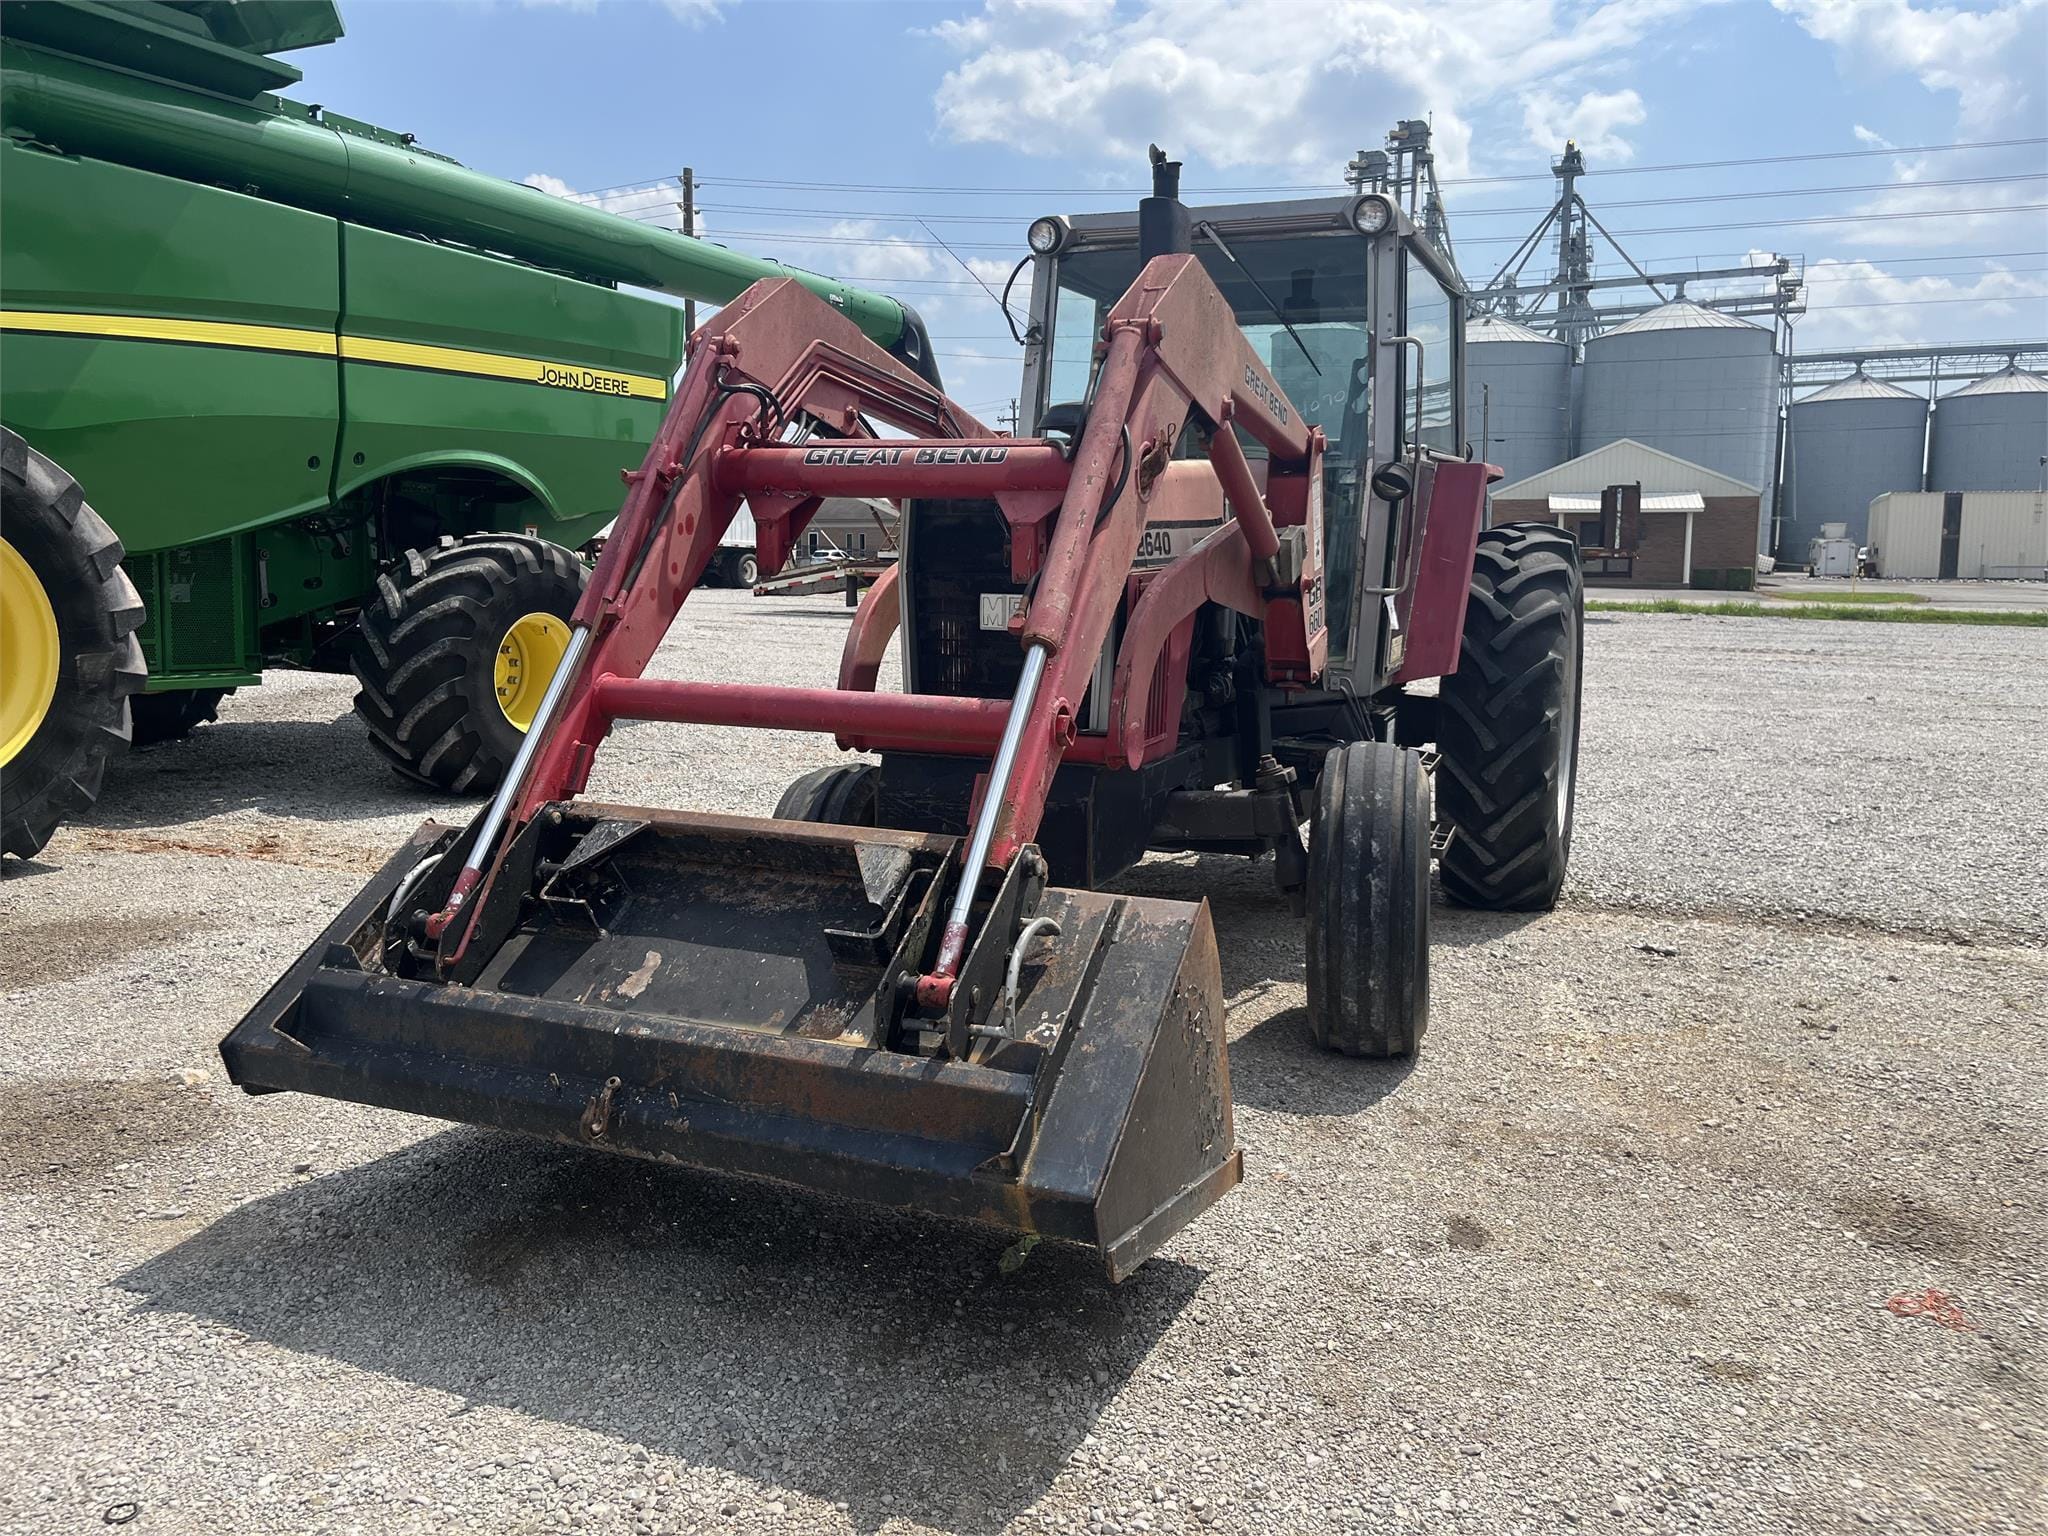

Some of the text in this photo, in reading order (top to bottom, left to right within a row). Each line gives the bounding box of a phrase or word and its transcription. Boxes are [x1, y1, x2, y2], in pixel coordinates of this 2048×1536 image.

[537, 365, 630, 394] JOHN DEERE
[1244, 363, 1288, 427] GREAT BEND
[804, 447, 1009, 466] GREAT BEND
[1136, 531, 1171, 557] 2640
[1309, 606, 1322, 635] 660
